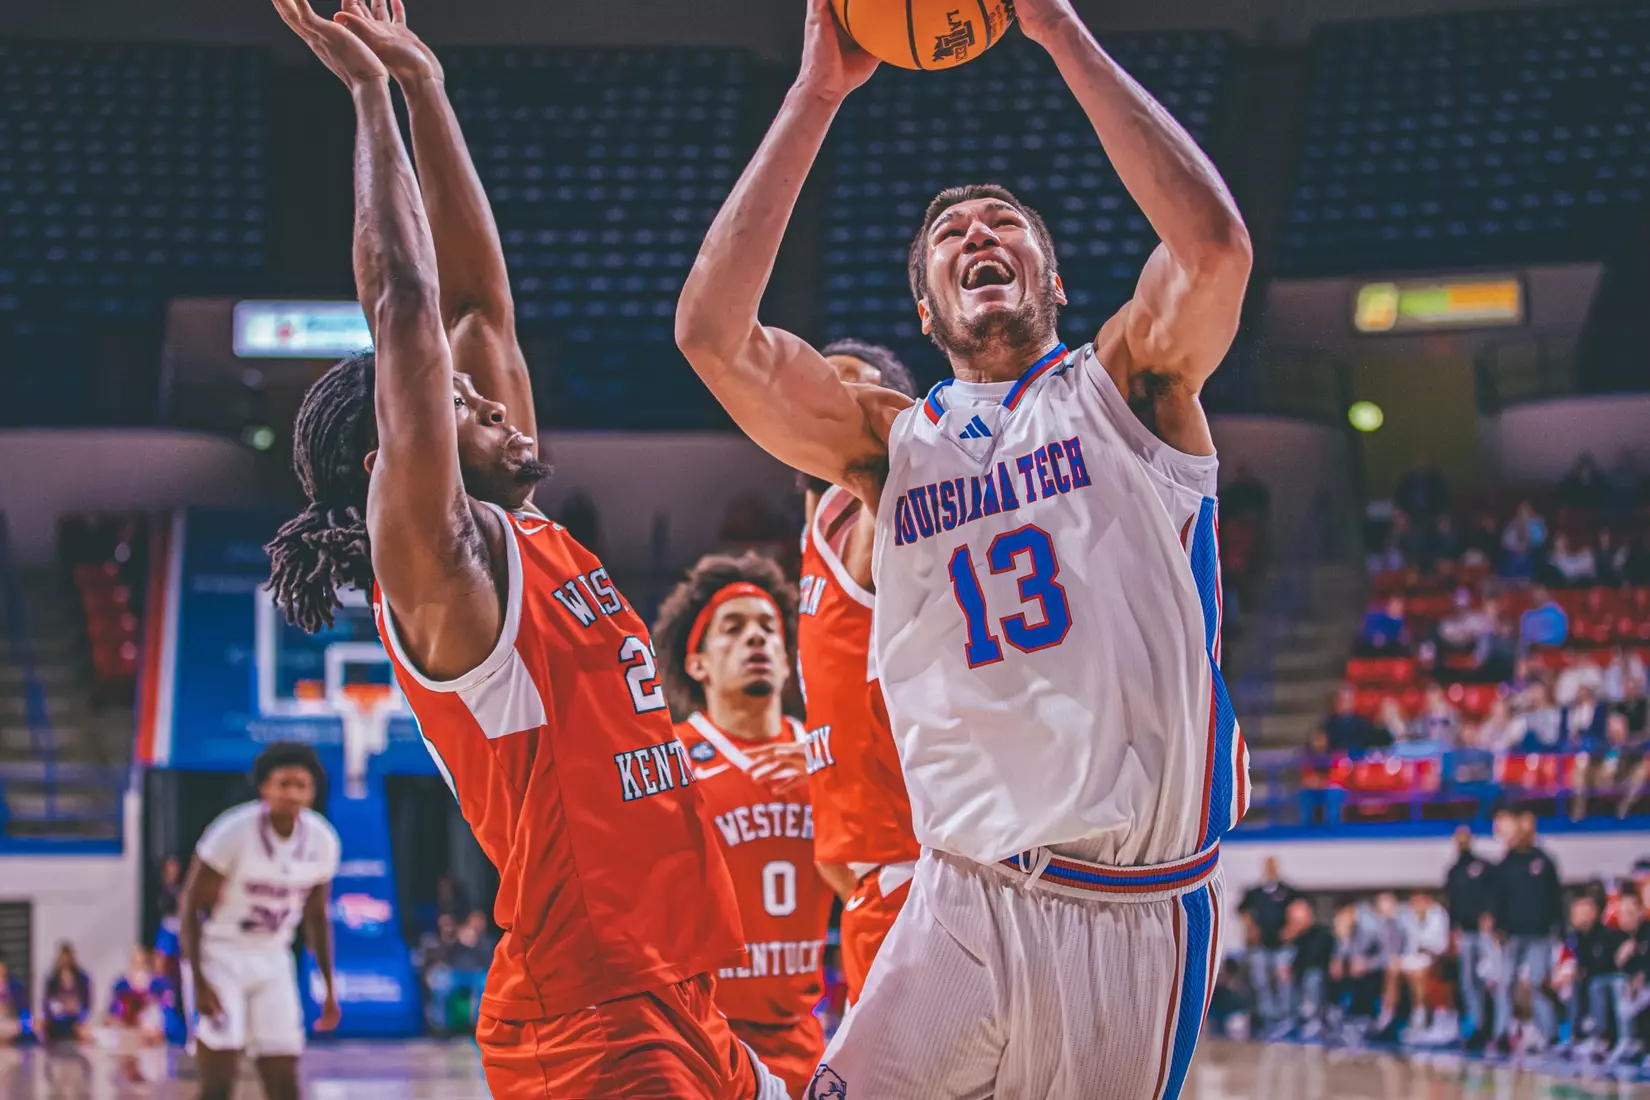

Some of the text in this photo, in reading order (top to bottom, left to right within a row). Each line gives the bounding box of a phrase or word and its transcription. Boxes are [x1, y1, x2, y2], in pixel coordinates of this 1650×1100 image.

[1016, 435, 1092, 504] TECH
[947, 522, 1074, 670] 13
[618, 634, 669, 715] 2
[614, 738, 697, 803] KENT
[762, 860, 797, 917] 0
